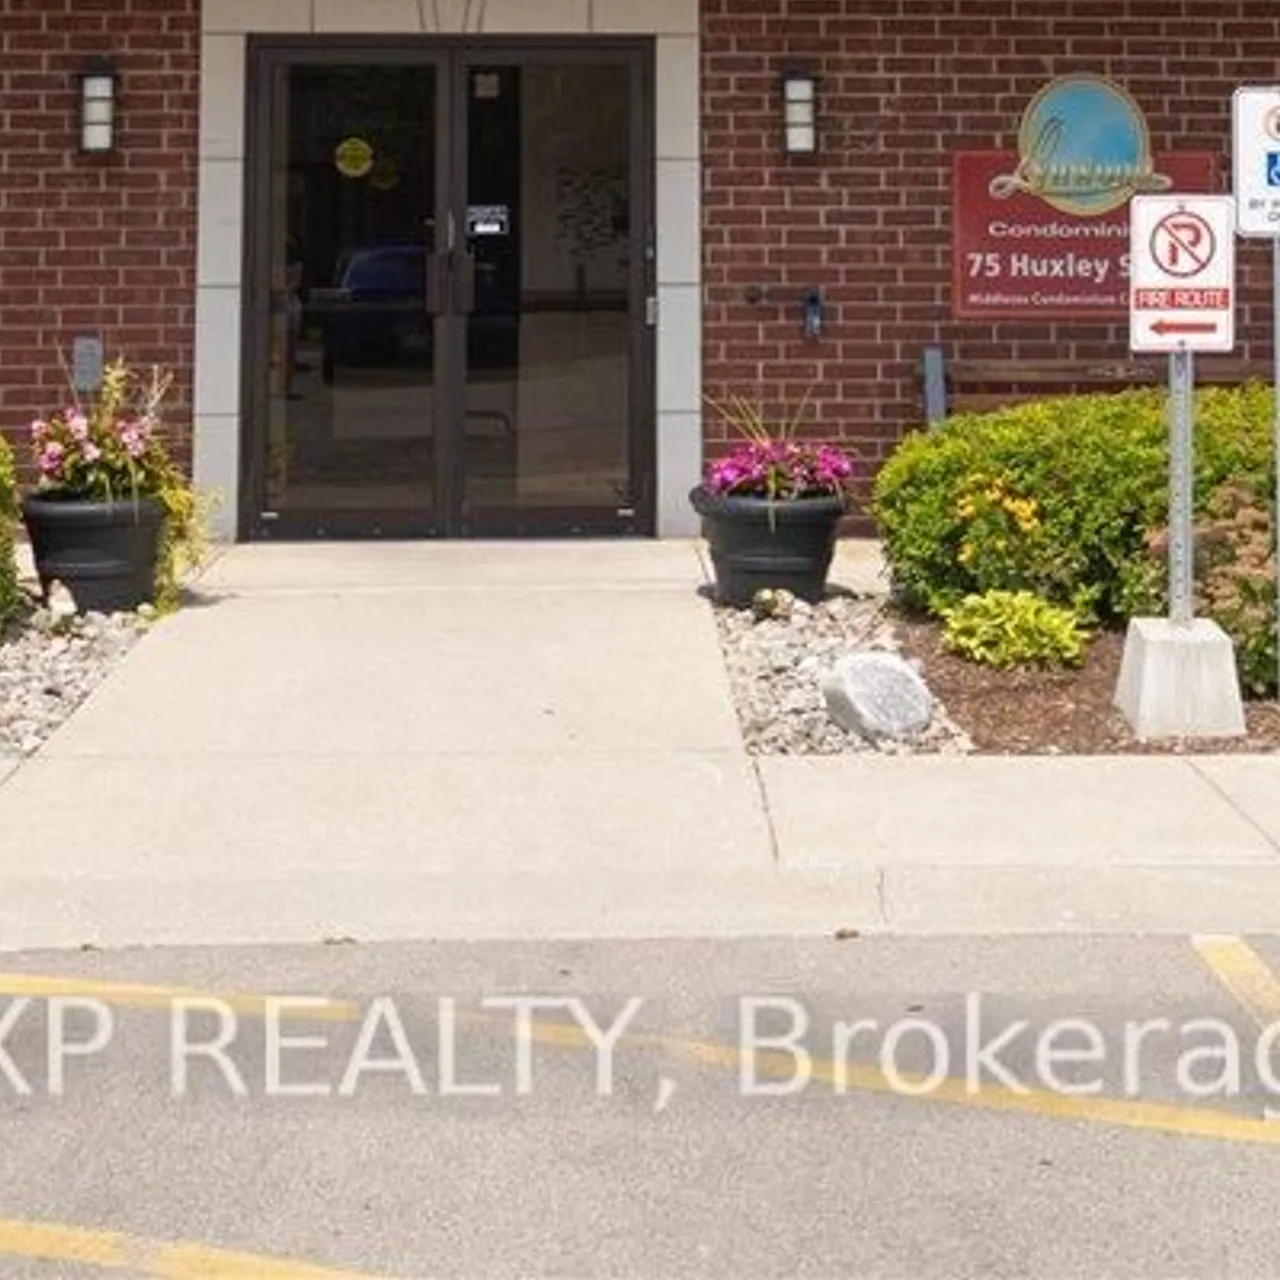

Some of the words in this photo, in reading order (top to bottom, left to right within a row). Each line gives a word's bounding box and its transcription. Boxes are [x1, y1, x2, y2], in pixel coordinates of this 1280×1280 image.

[988, 220, 1131, 239] Condomini
[967, 252, 1001, 277] 75
[1010, 252, 1109, 283] Huxley
[1138, 290, 1173, 309] FIRE
[1174, 290, 1229, 309] ROUTE
